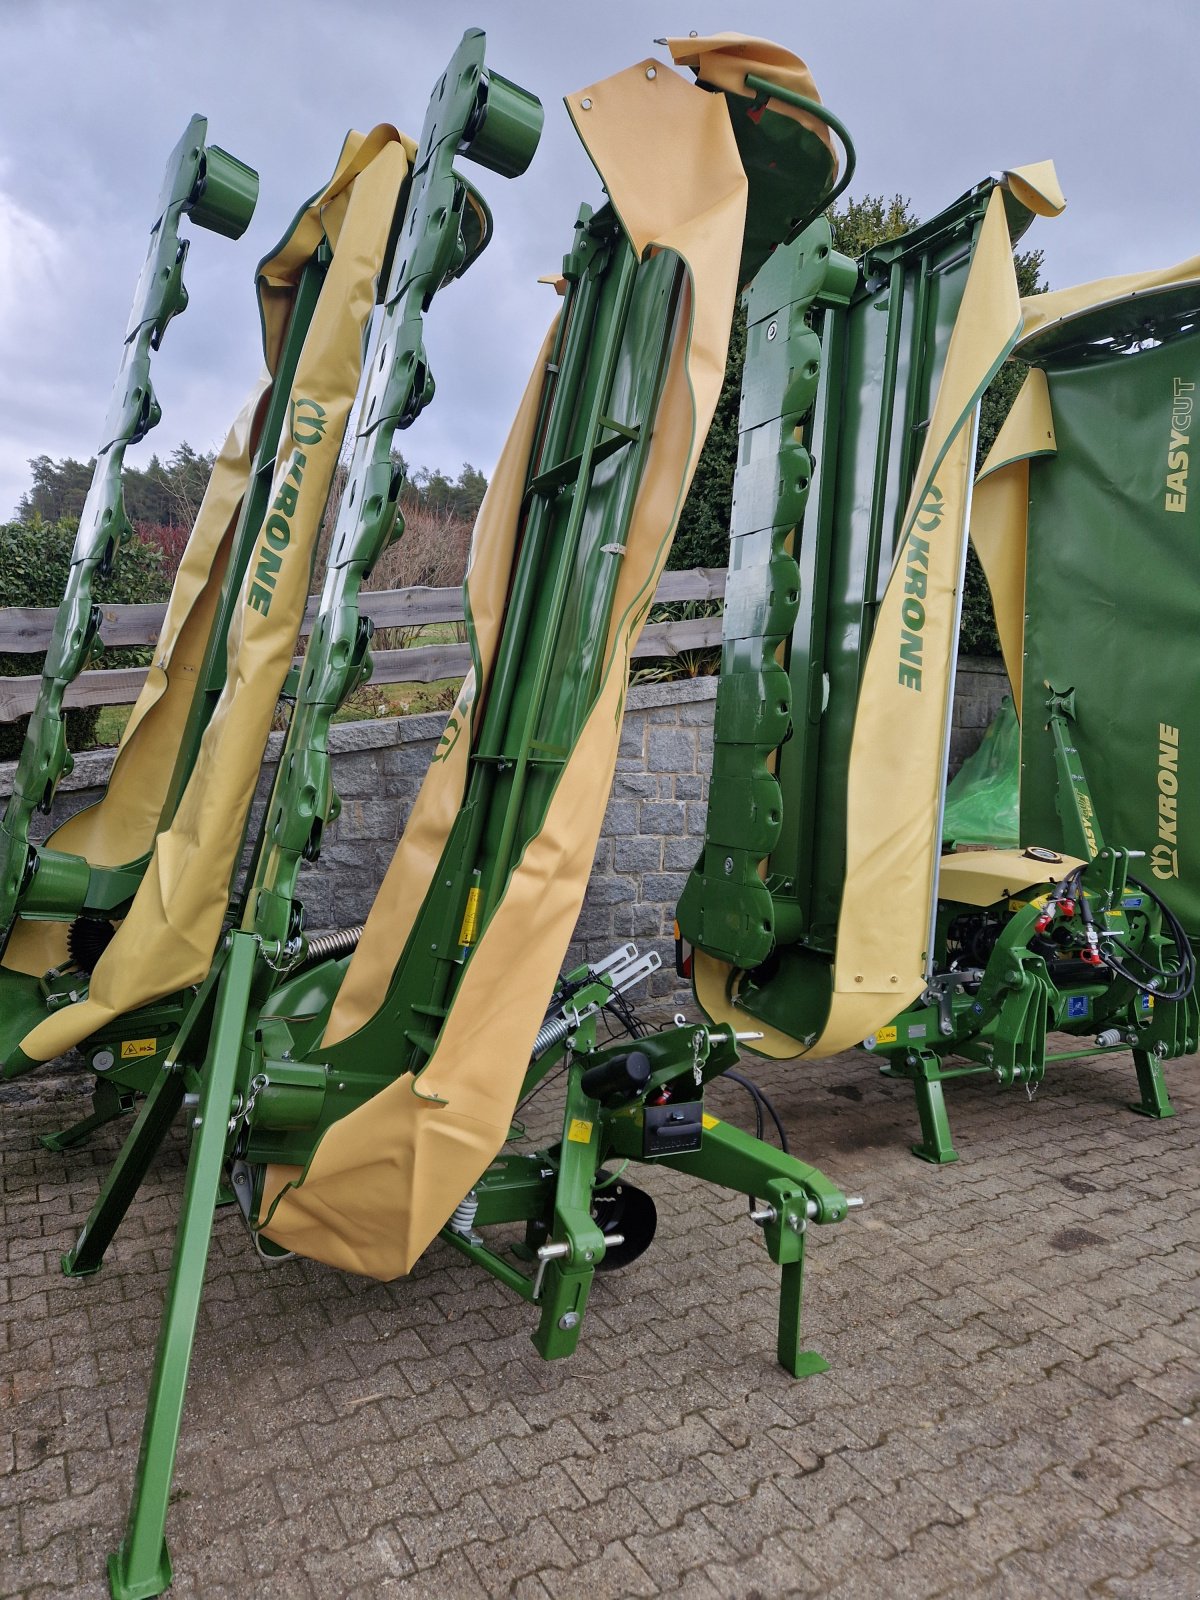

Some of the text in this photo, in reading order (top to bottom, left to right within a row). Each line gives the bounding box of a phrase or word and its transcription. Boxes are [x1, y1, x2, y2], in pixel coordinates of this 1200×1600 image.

[1165, 377, 1195, 513] EASYCUT
[247, 450, 308, 617] KRONE
[898, 533, 930, 692] KRONE
[1157, 722, 1180, 845] KRONE
